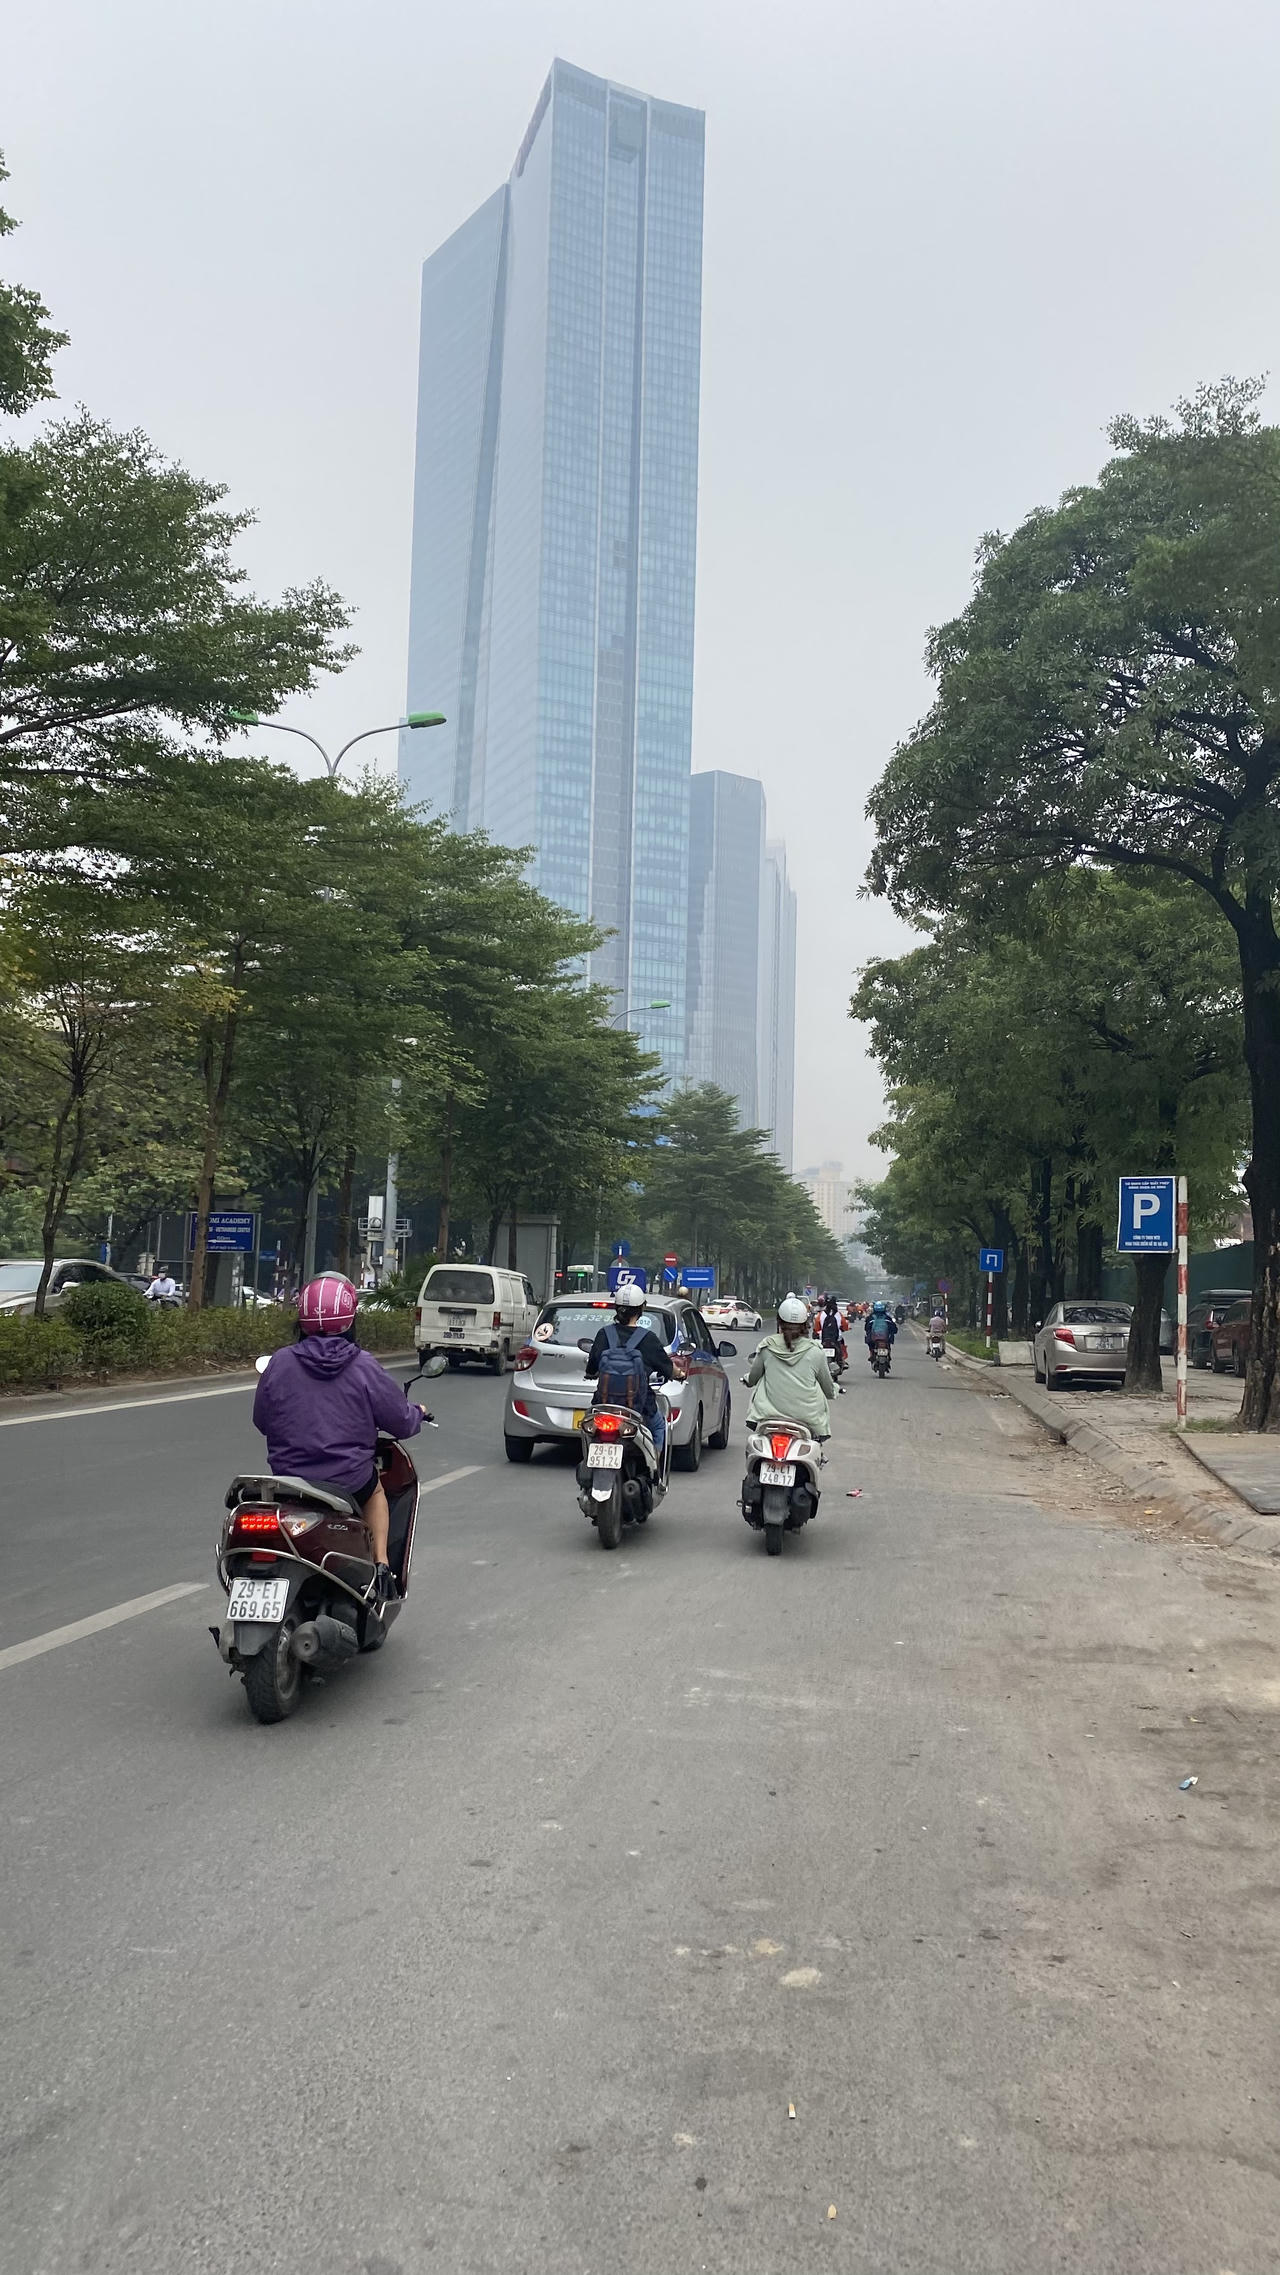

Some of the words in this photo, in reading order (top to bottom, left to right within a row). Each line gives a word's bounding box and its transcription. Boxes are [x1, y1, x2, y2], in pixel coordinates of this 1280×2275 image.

[1133, 1194, 1160, 1229] P
[593, 1445, 617, 1456] 29-G1
[590, 1456, 618, 1467] 951.24
[237, 1581, 279, 1599] 29-E1
[230, 1600, 281, 1619] 669.65
